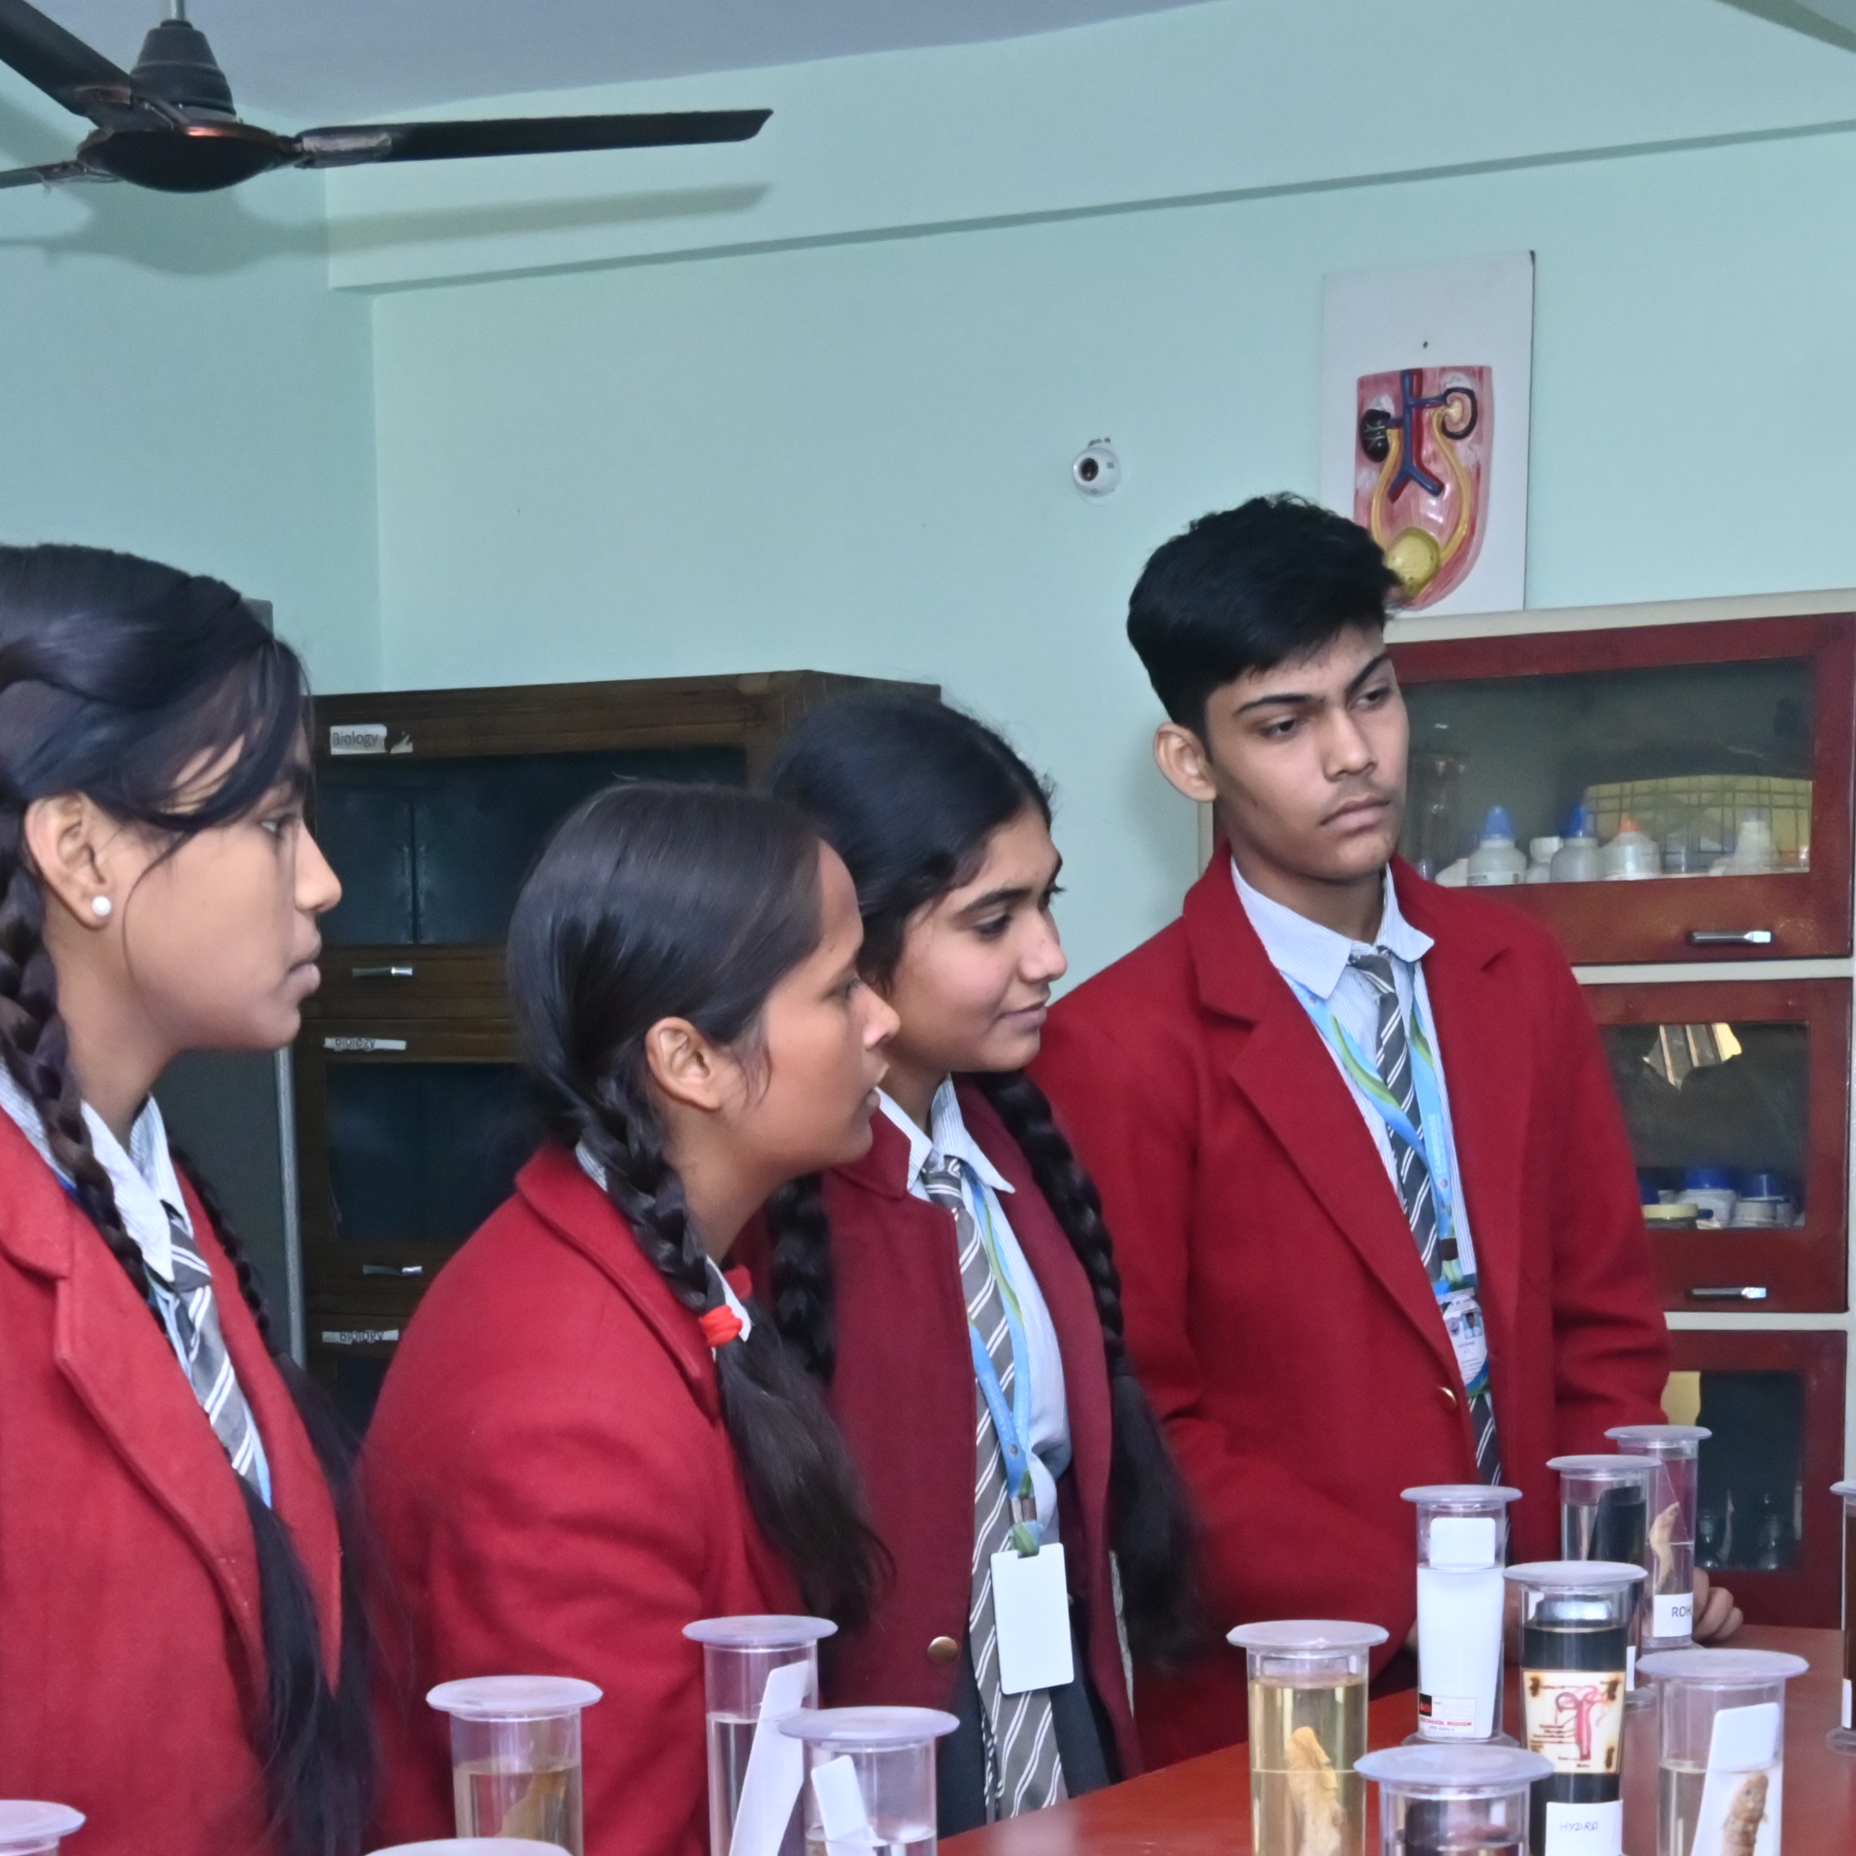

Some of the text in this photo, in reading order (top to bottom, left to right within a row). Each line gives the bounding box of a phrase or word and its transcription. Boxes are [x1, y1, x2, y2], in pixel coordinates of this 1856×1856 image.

[332, 729, 379, 748] Biology
[1427, 1113, 1443, 1175] CAMBRIDGE
[1015, 1374, 1028, 1436] AMBRIDGE
[1559, 1821, 1599, 1833] HYDRA
